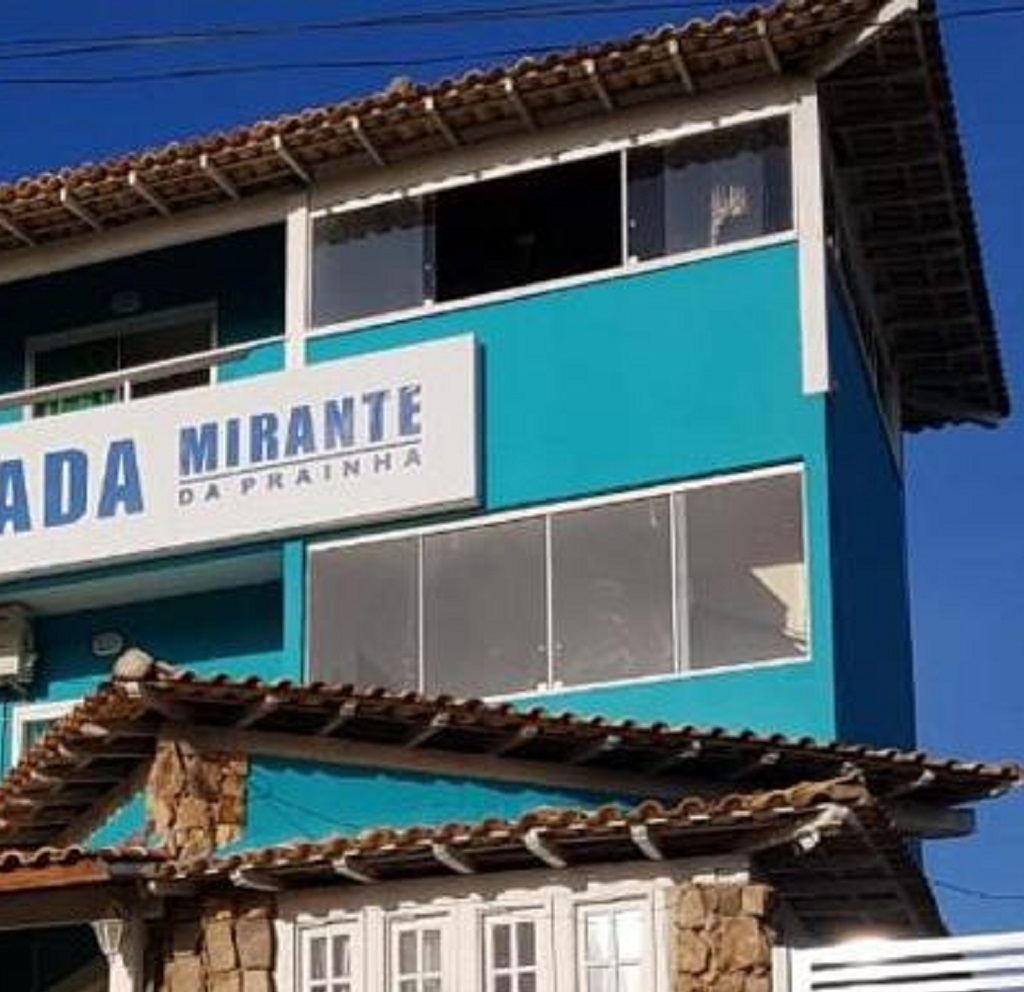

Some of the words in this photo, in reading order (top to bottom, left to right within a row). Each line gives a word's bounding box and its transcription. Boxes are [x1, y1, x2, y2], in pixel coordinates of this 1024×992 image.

[179, 384, 422, 476] MIRANTE
[179, 484, 221, 506] DA
[241, 448, 423, 496] PRAINHA
